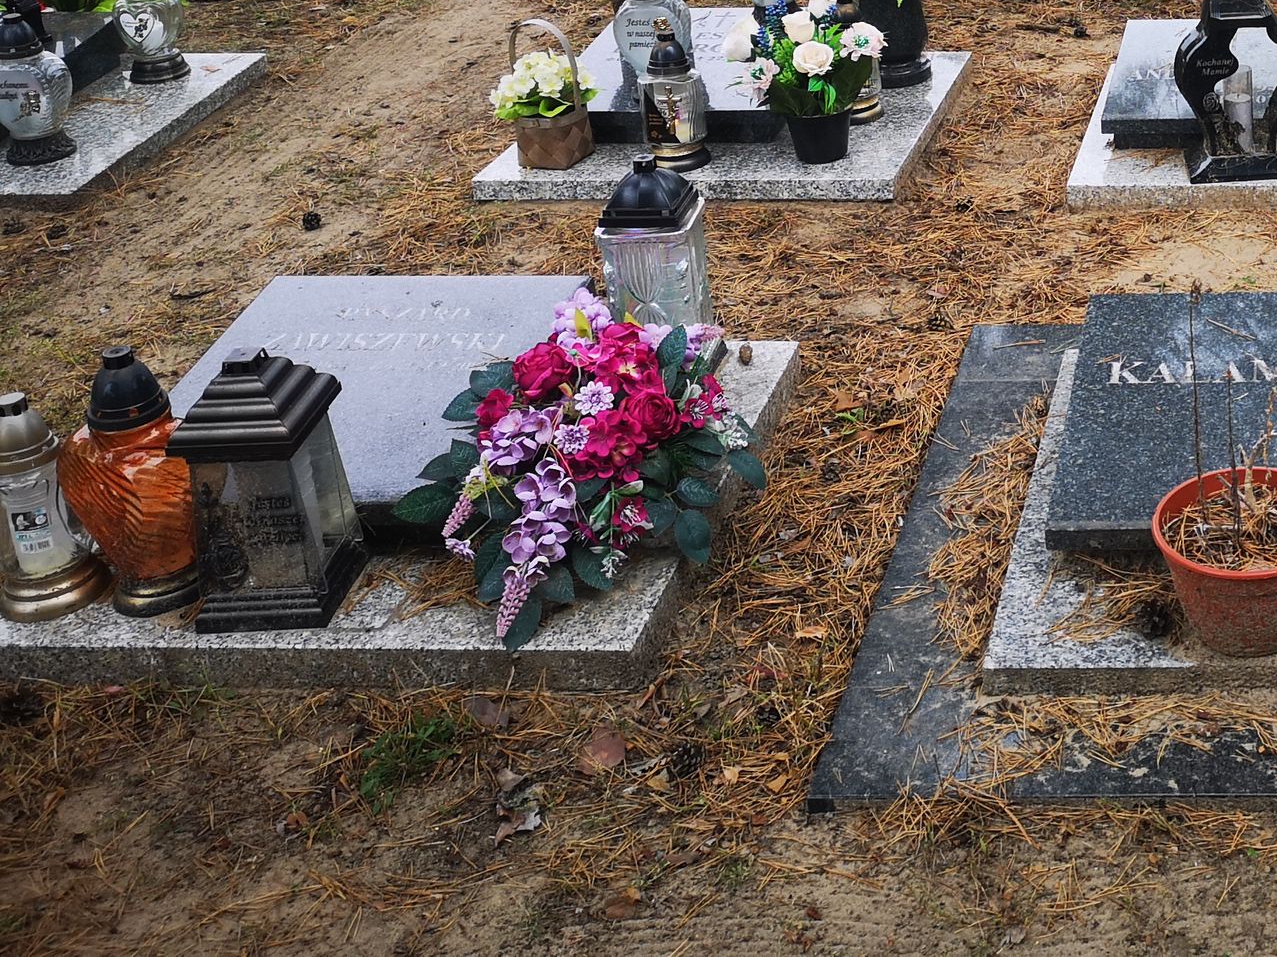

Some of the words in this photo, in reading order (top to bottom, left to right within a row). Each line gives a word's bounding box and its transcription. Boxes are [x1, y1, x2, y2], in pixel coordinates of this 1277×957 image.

[625, 18, 651, 27] Jesteś
[1196, 58, 1234, 67] Kochanej
[1201, 67, 1230, 76] Mamie
